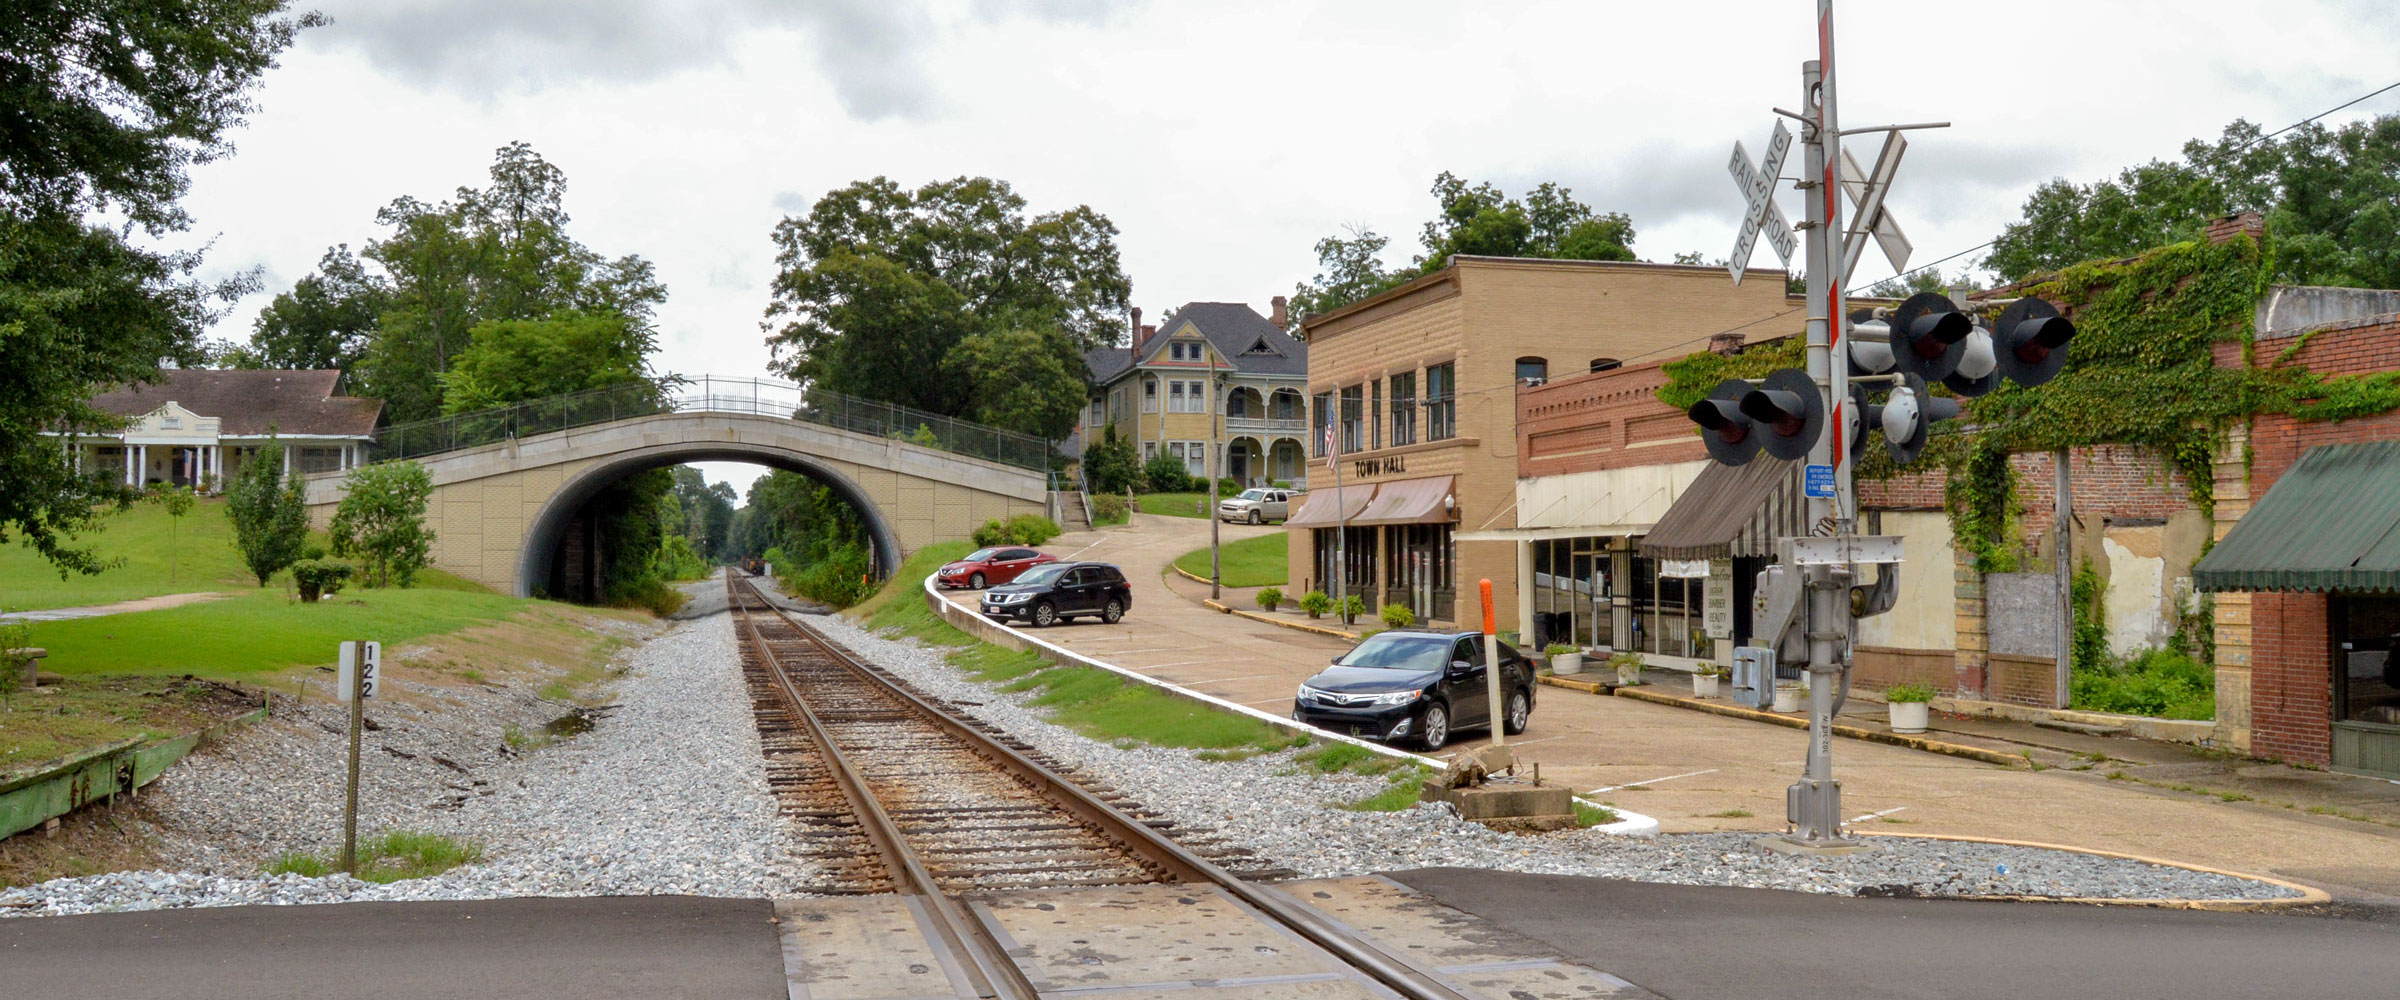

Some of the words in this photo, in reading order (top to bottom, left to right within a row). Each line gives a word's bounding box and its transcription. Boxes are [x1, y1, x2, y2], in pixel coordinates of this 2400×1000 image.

[1733, 133, 1784, 271] CROSSING
[1355, 459, 1379, 477] TOWN
[1383, 456, 1406, 474] HALL
[1708, 599, 1726, 609] BARBER
[1709, 613, 1726, 622] BEAUTY
[362, 645, 374, 698] 122
